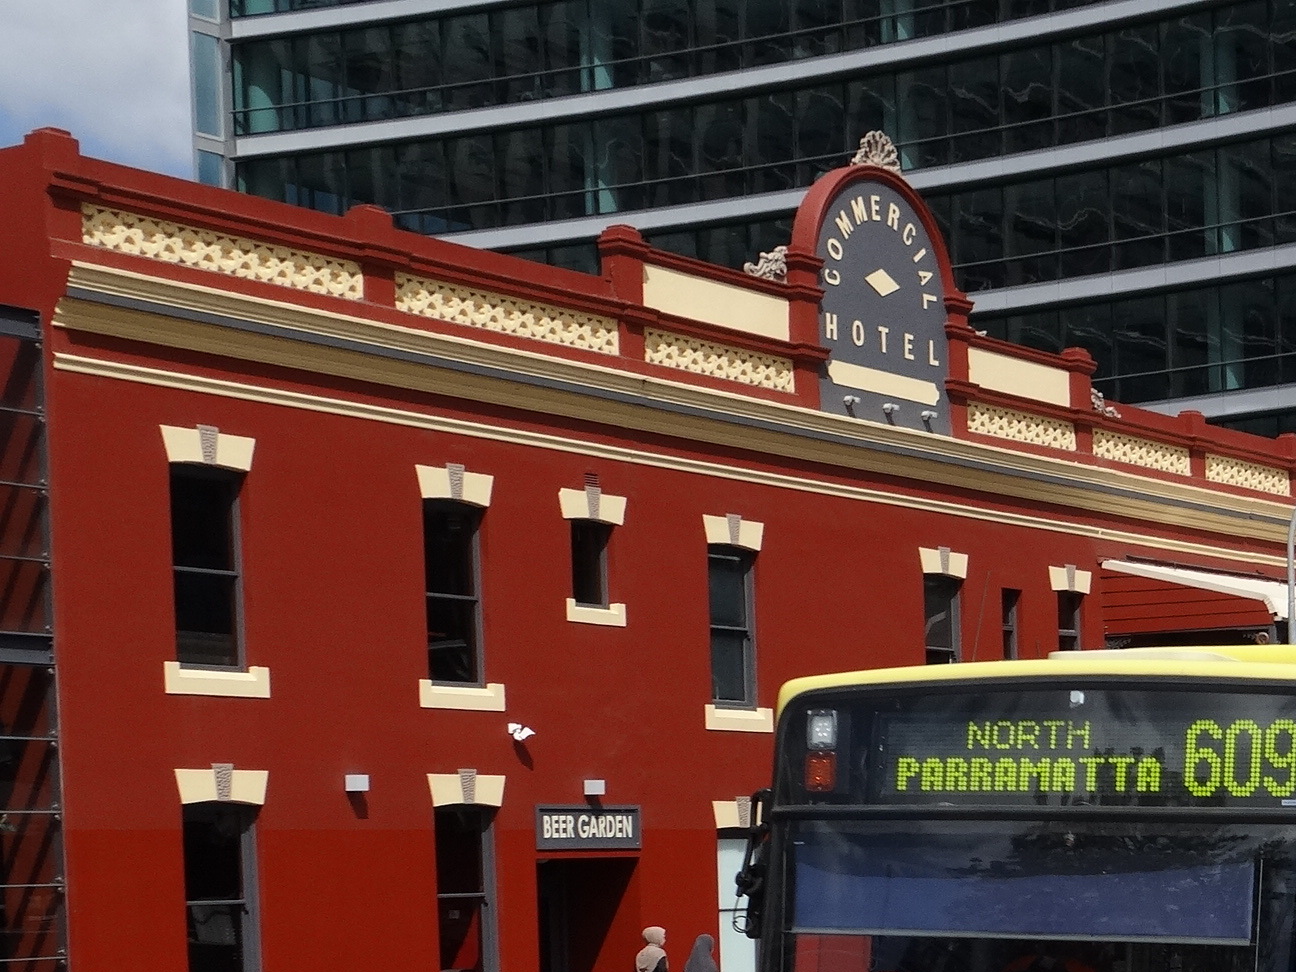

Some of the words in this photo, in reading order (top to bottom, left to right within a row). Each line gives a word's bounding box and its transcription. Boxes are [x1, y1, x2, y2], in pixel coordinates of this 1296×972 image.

[824, 195, 937, 310] COMMERCIAL
[825, 312, 940, 367] HOTEL
[967, 719, 1092, 751] NORTH
[896, 756, 1162, 793] PARRAMATTA
[542, 815, 575, 839] BEER
[577, 814, 633, 839] GARDEN
